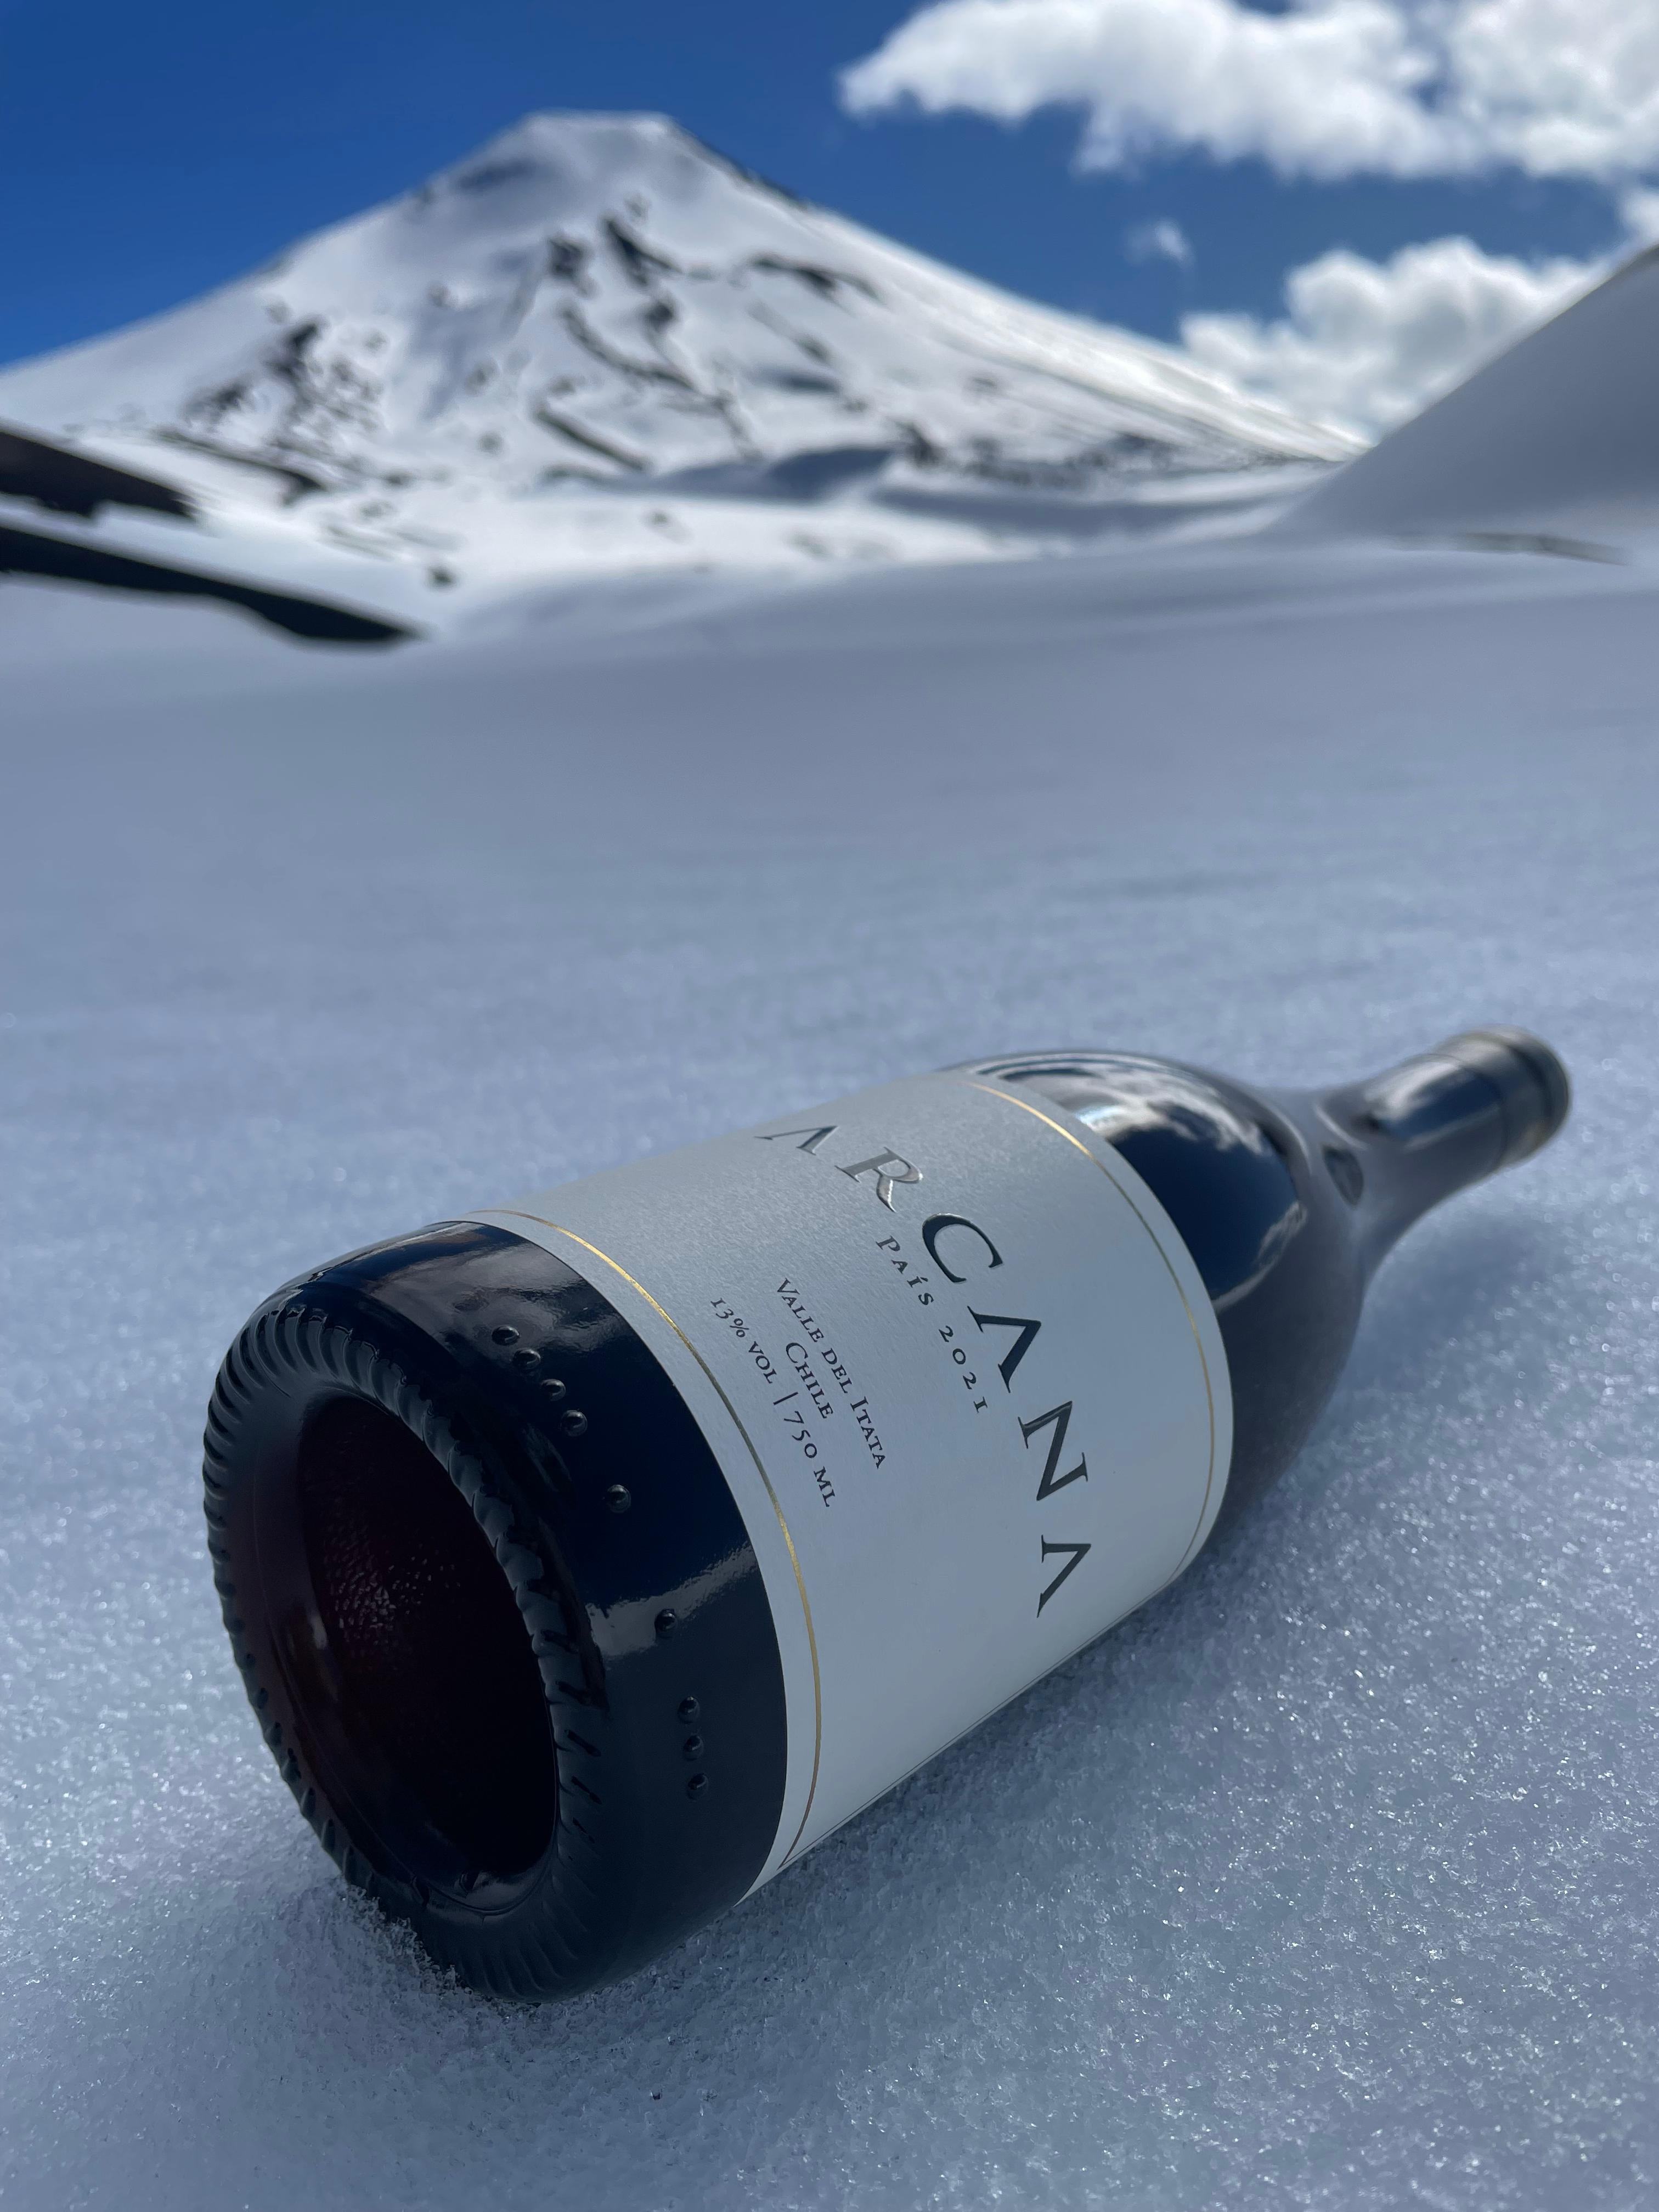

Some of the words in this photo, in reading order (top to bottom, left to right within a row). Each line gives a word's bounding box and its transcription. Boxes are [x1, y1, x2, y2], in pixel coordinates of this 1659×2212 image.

[710, 1297, 749, 1338] 13%
[783, 1410, 817, 1459] 750
[939, 1325, 988, 1413] 2021
